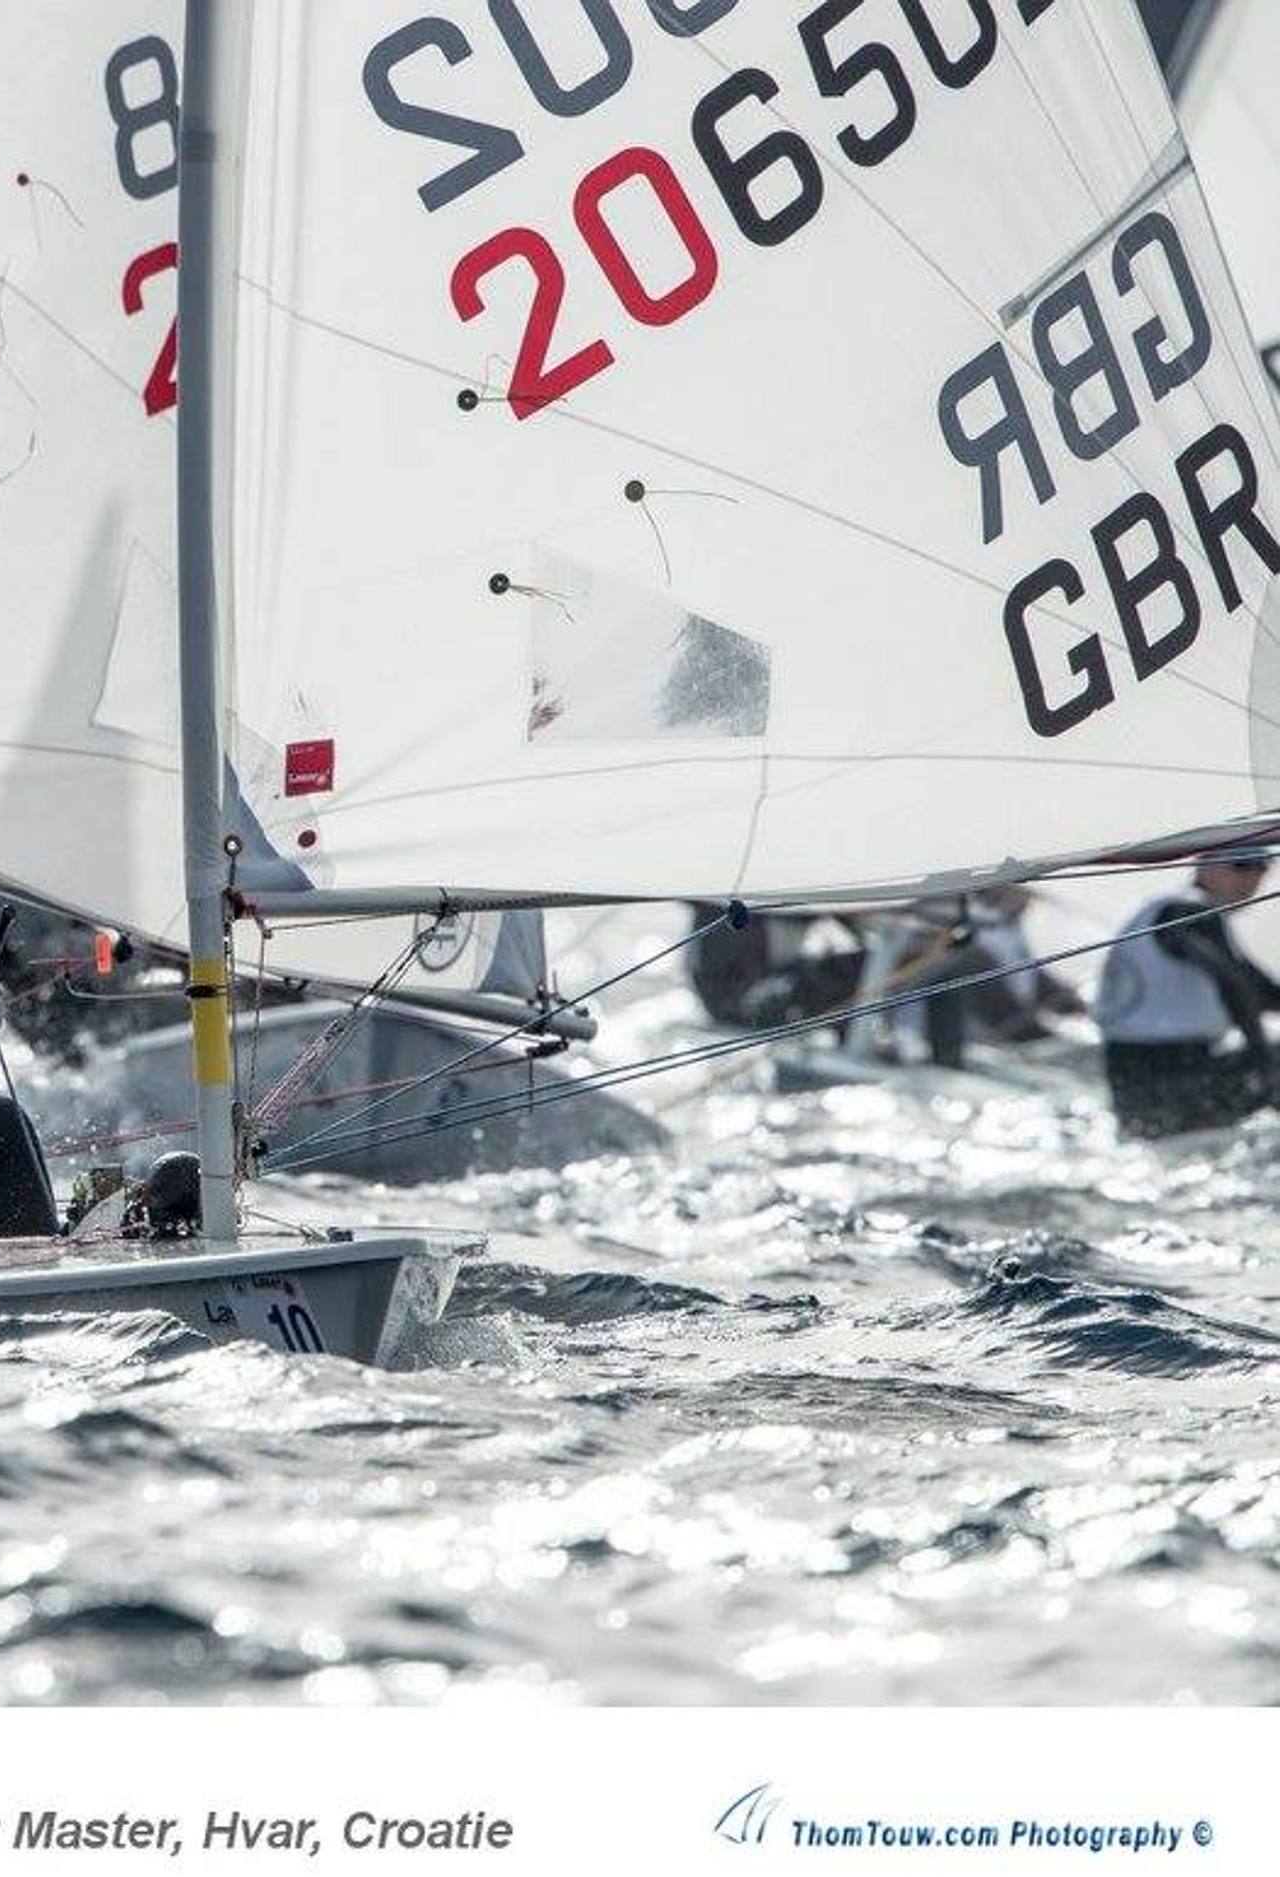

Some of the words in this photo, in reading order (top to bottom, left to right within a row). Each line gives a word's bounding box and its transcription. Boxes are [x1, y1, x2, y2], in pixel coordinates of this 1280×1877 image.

[450, 0, 1058, 421] 20650
[1003, 422, 1280, 737] GBR
[267, 1303, 325, 1354] 10
